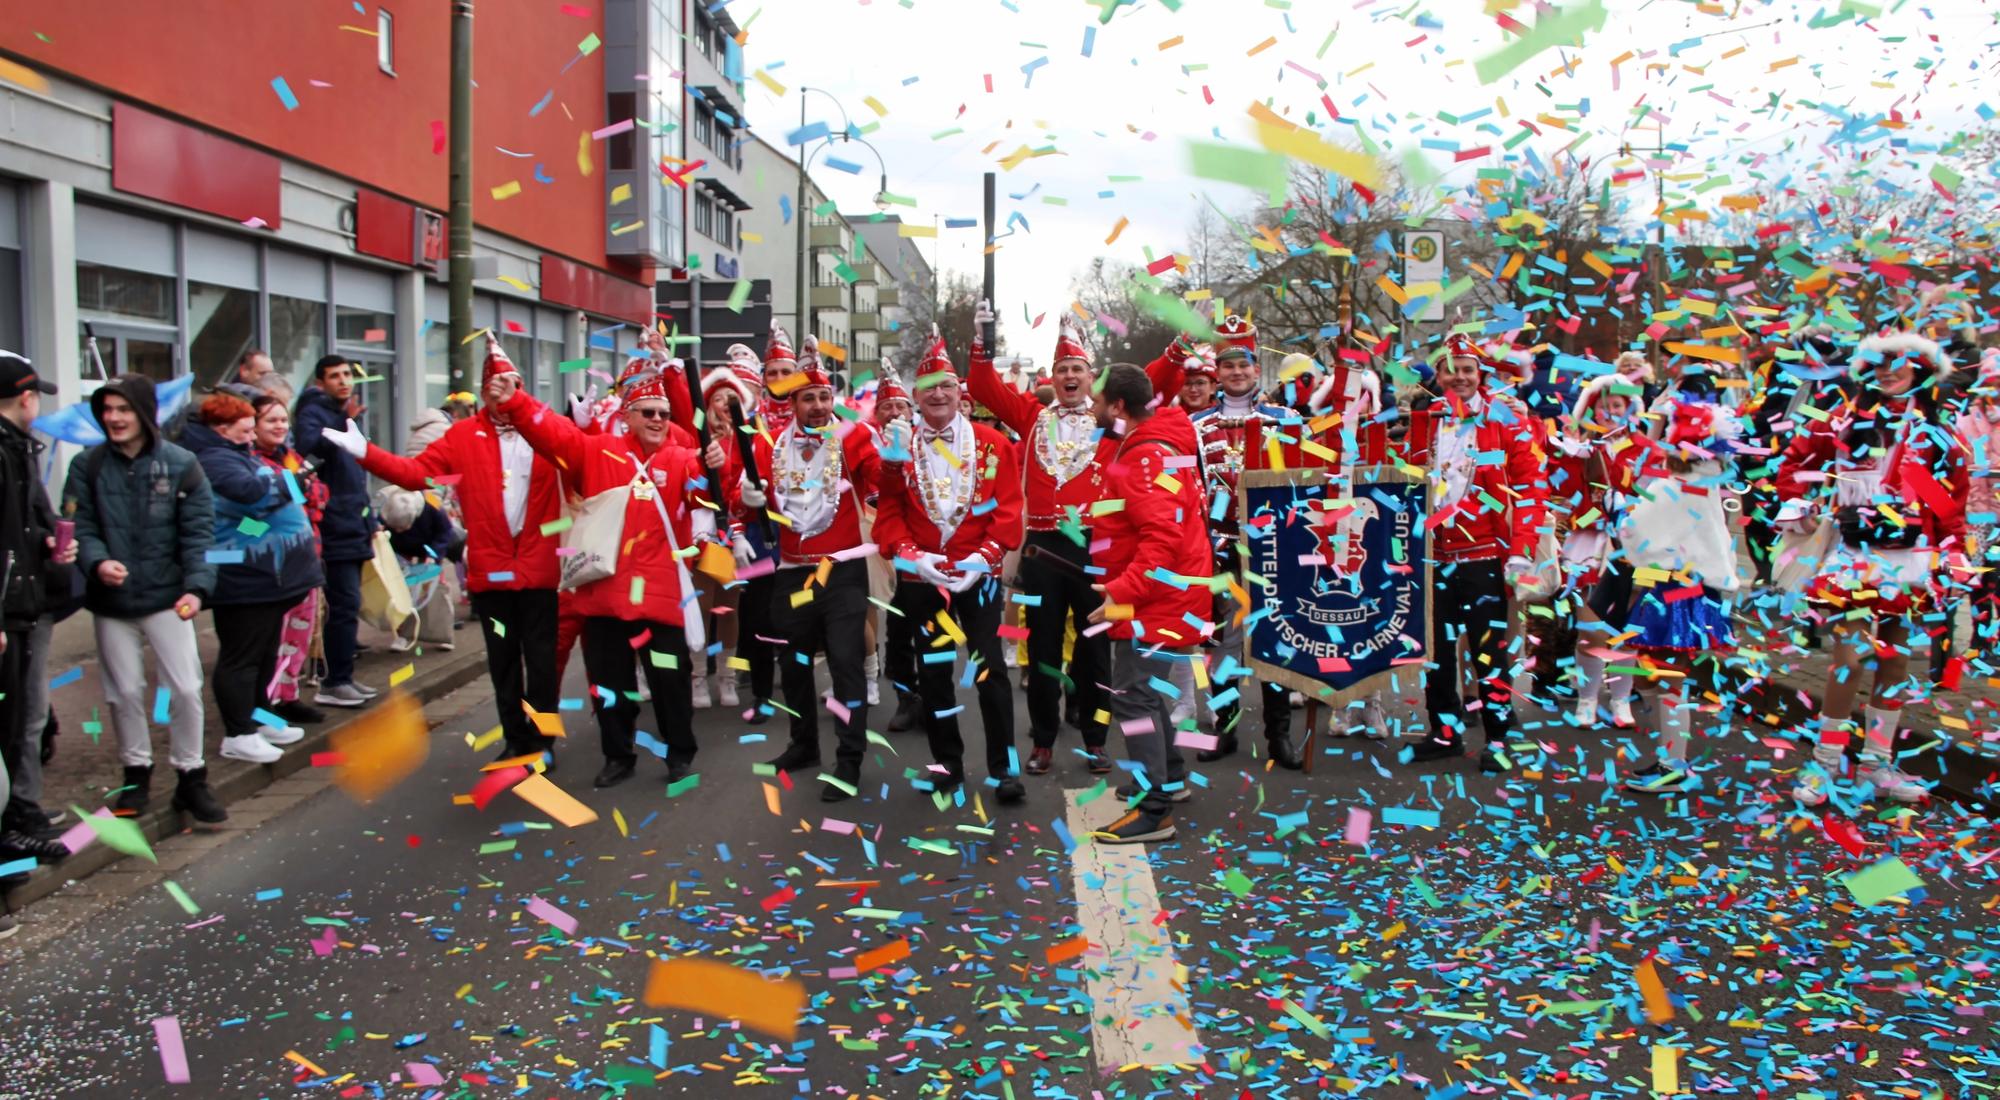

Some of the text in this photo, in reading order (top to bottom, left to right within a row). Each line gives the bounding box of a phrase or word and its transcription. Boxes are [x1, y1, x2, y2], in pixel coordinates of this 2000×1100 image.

[1419, 242, 1430, 255] H
[1353, 580, 1411, 657] CARNEVAL
[1395, 511, 1410, 565] CLUB
[1314, 611, 1361, 622] DESSAU
